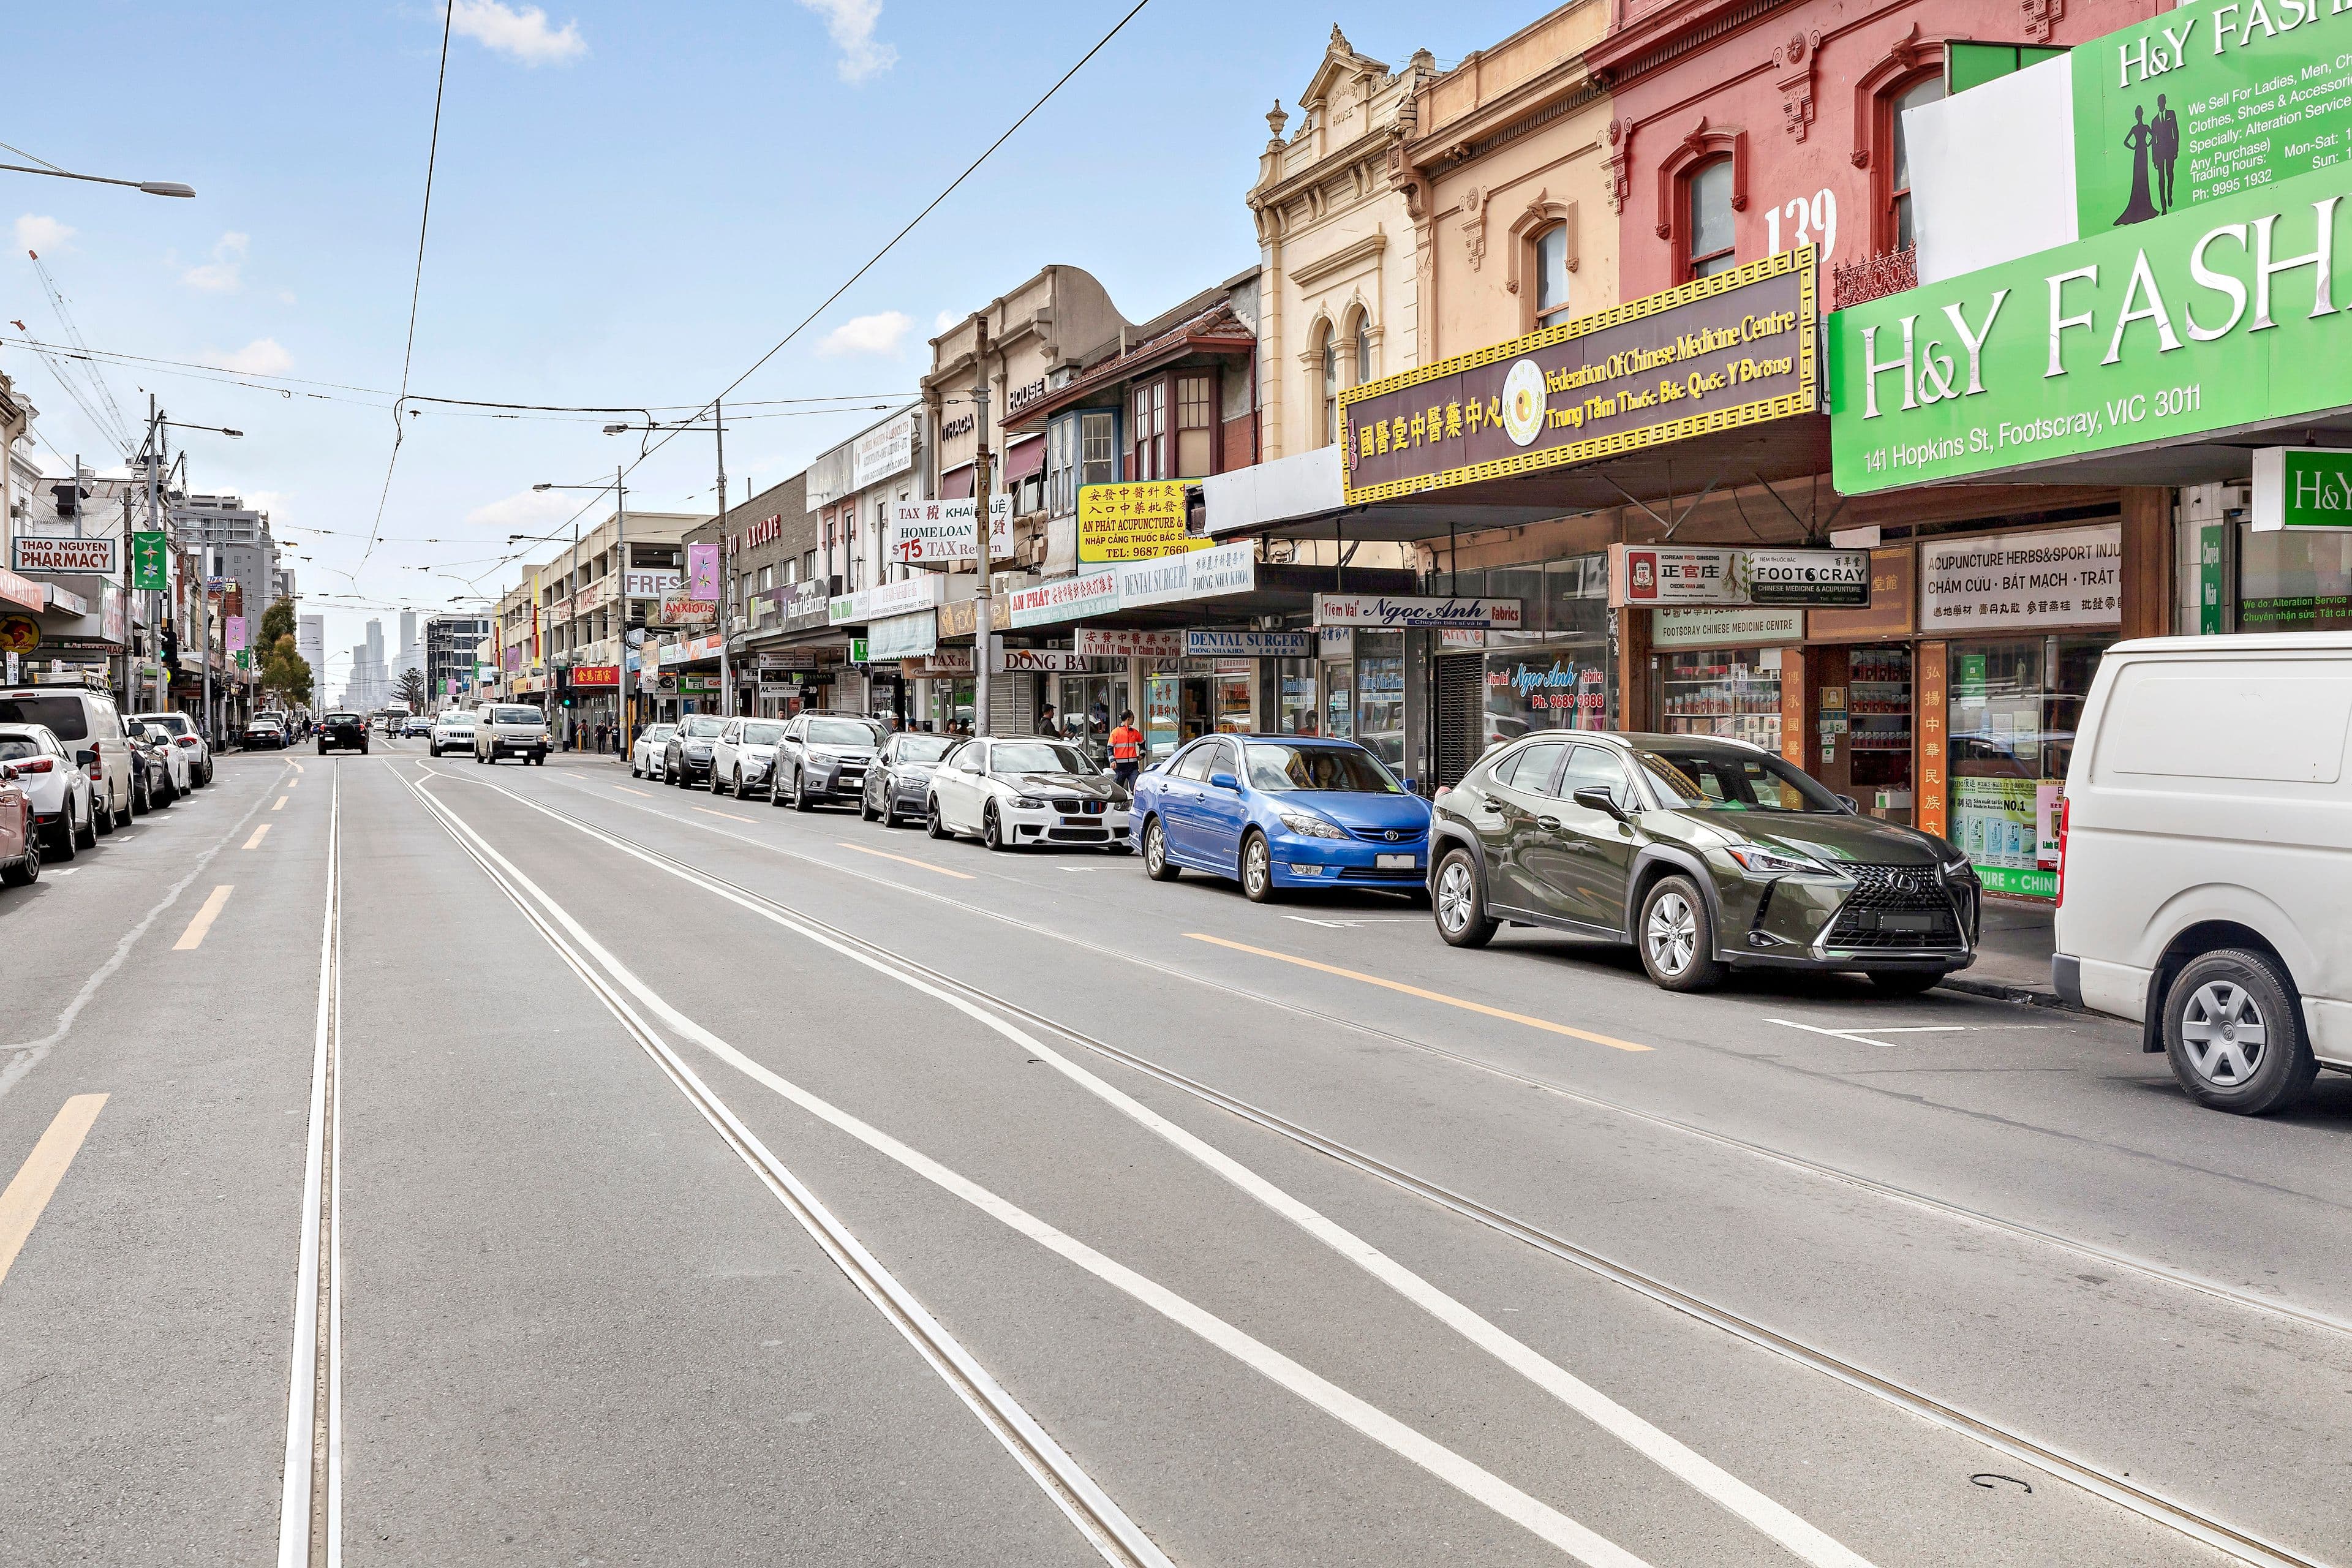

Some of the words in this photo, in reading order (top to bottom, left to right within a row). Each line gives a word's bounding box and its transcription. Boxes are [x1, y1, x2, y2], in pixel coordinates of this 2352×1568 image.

[2117, 19, 2198, 88] H&Y
[2188, 103, 2205, 116] We
[2209, 92, 2228, 109] Sell
[2233, 88, 2252, 102] For
[2255, 75, 2297, 96] Ladies,
[2302, 63, 2332, 80] Men,
[1333, 106, 1353, 127] HOUSE
[2189, 114, 2234, 135] Clothes,
[2238, 100, 2274, 120] Shoes
[2277, 94, 2286, 107] &
[2189, 131, 2242, 153] Specially:
[2245, 111, 2301, 138] Alteration
[2305, 96, 2351, 119] Service
[2190, 158, 2211, 172] Any
[2214, 137, 2271, 161] Purchase)
[2190, 165, 2229, 184] Trading
[2233, 154, 2267, 172] hours:
[2285, 134, 2339, 158] Mon-Sat:
[2312, 153, 2339, 169] Sun:
[2192, 189, 2209, 202] Ph:
[2212, 178, 2239, 197] 9995
[2244, 168, 2272, 187] 1932
[1765, 188, 1837, 263] 139
[1862, 289, 2011, 419] H&Y
[2044, 195, 2352, 378] FASH
[1545, 364, 1607, 394] Federation
[1606, 354, 1624, 379] Of
[1623, 344, 1676, 375] Chinese
[1676, 325, 1741, 361] Medicine
[1741, 311, 1796, 342] Centre
[1010, 378, 1045, 410] HOUSE
[1546, 405, 1584, 429] Trung
[1585, 394, 1616, 419] Tâm
[1727, 361, 1743, 385] Y
[942, 413, 974, 442] ITHACA
[1360, 395, 1504, 458] 國醫堂中醫藥中心
[1864, 451, 1887, 473] 141
[1893, 436, 1964, 469] Hopkins
[1969, 428, 1994, 455] St,
[1998, 409, 2103, 448] Footscray,
[2106, 394, 2146, 427] VIC
[2154, 383, 2201, 417] 3011
[899, 508, 920, 519] TAX
[1083, 521, 1094, 532] AN
[1096, 516, 1116, 532] PHÁT
[1118, 518, 1175, 530] ACUPUNCTURE
[1177, 516, 1183, 527] &
[747, 514, 782, 549] ARCADE
[900, 527, 937, 538] HOME
[940, 525, 973, 537] LOAN
[21, 541, 53, 550] THAO
[59, 542, 107, 551] NGUYEN
[927, 541, 957, 556] TAX
[959, 544, 1002, 554] Retrn
[1106, 549, 1129, 558] TEL:
[1133, 547, 1159, 557] 9687
[1164, 545, 1189, 554] 7660
[1928, 552, 2004, 571] ACUPUNCTURE
[2007, 545, 2092, 565] HERBS&SPORT
[21, 552, 110, 568] PHARMACY
[1661, 565, 1720, 578] 正官庄
[1835, 557, 1861, 567] 百草堂
[1125, 572, 1153, 597] DENTAL
[1154, 565, 1189, 592] SURGERY
[1215, 573, 1229, 588] NHA
[1230, 569, 1249, 585] KHOA
[1928, 577, 1961, 594] CHÂM
[2030, 573, 2068, 589] MẠCH
[2081, 568, 2114, 586] TRẬT
[581, 586, 598, 610] MARKET
[665, 603, 715, 613] ANXIOUS
[788, 598, 798, 619] Bank
[803, 593, 826, 616] Melbourne
[1012, 595, 1024, 611] AN
[1027, 587, 1049, 608] PHÁT
[1428, 599, 1487, 619] Anh
[1491, 605, 1518, 621] Fabrics
[2244, 601, 2255, 609] We
[2273, 598, 2313, 607] Alteration
[2315, 596, 2347, 605] Service
[1190, 633, 1243, 646] DENTAL
[1247, 633, 1306, 647] SURGERY
[1663, 625, 1700, 637] FOOTSCRAY
[1703, 624, 1729, 635] CHINESE
[1732, 621, 1763, 633] MEDICINE
[1766, 619, 1793, 630] CENTRE
[932, 655, 957, 666] TAX
[1082, 644, 1092, 654] AN
[1095, 643, 1115, 655] PHÁT
[1133, 645, 1137, 654] Y
[1065, 655, 1088, 671] BA
[1544, 660, 1577, 687] Anh
[1582, 668, 1602, 684] Fabrics
[1532, 695, 1548, 709] Ph.
[1550, 694, 1575, 708] 9689
[2003, 801, 2026, 812] NO.1
